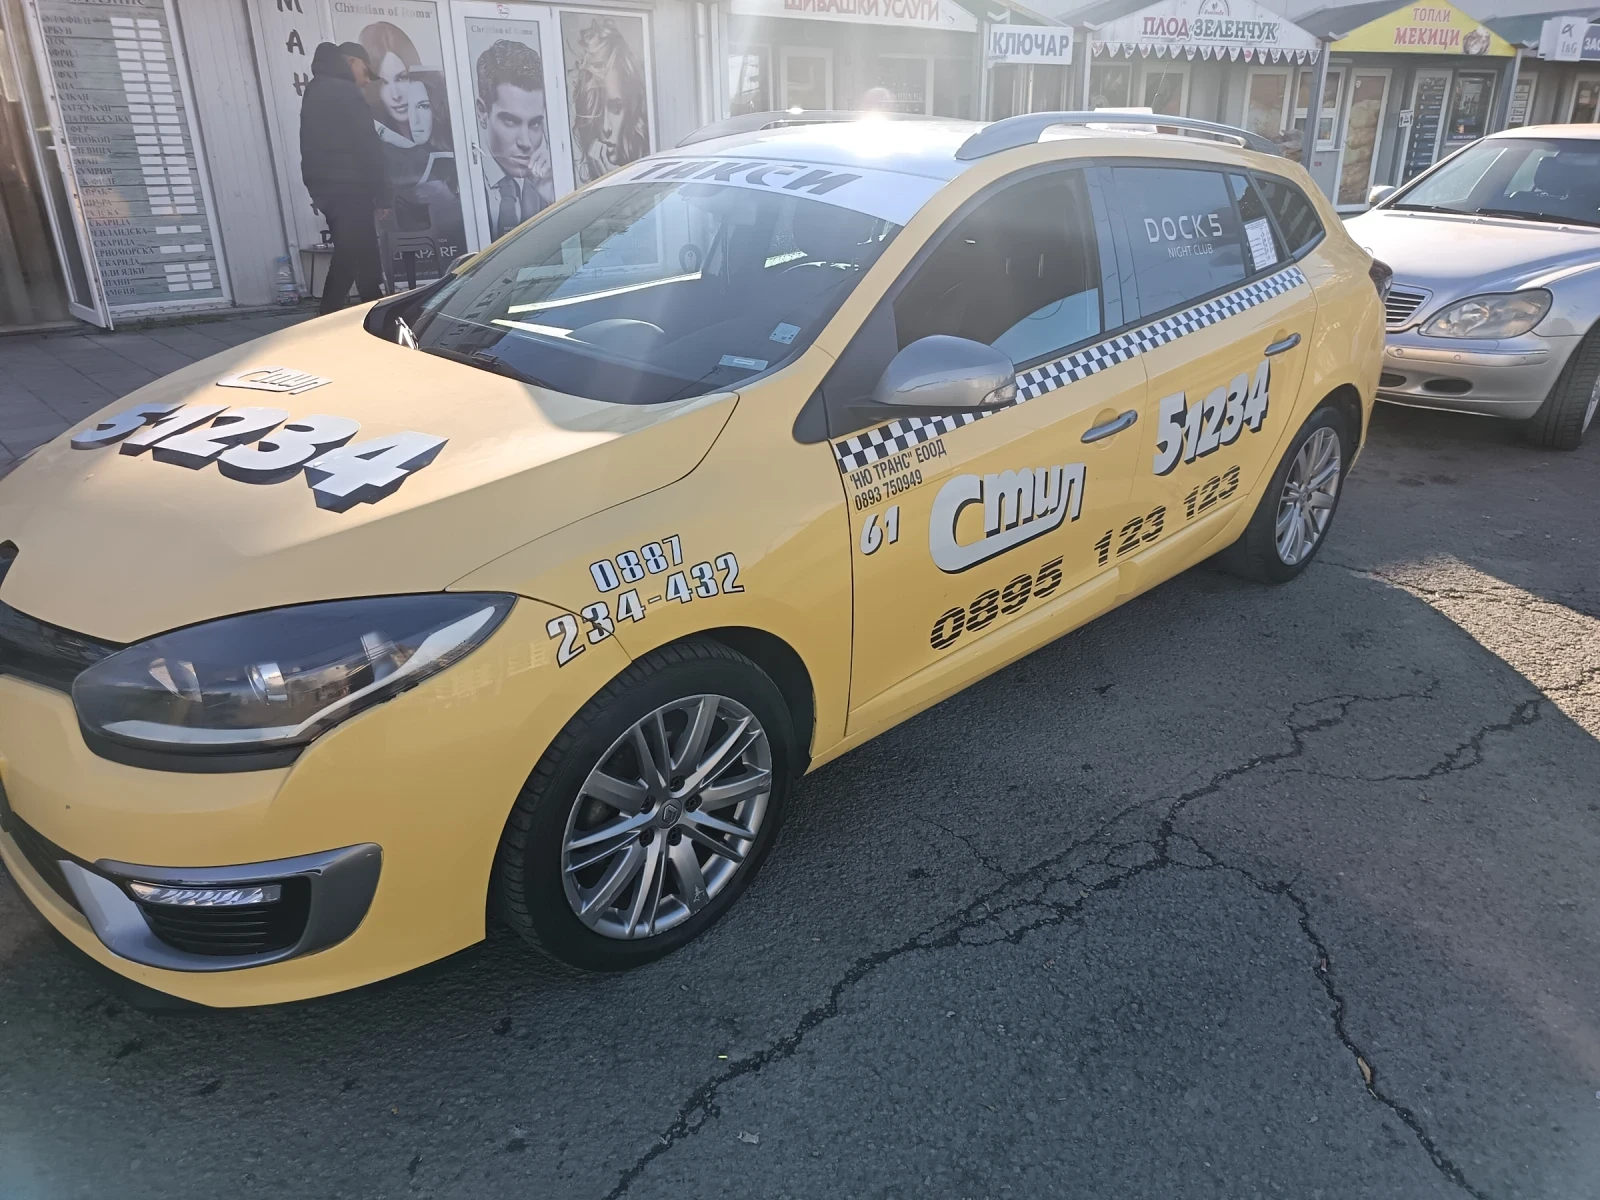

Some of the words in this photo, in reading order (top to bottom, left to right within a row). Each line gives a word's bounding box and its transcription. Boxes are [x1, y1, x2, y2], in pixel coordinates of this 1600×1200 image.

[388, 7, 400, 17] of
[883, 0, 940, 22] УСЛУГИ
[1412, 7, 1451, 23] ТОПЛИ
[1142, 16, 1190, 39] ПЛОД
[1193, 19, 1278, 41] ЗЕЛЕНЧУК
[1393, 27, 1461, 51] МЕКИЦИ
[992, 31, 1071, 57] КЛЮЧАР
[68, 136, 112, 144] ЕРНОКОП
[630, 159, 864, 196] ТАКСИ
[96, 247, 155, 258] ЕРНОМОРСКА
[1167, 246, 1193, 259] NIGHT
[1193, 243, 1214, 255] CLUB
[101, 269, 120, 278] ИДИ
[105, 287, 136, 298] АМСИЯ
[1152, 357, 1271, 477] 51234
[70, 402, 450, 515] 51234
[915, 438, 948, 464] ЕООД
[854, 486, 883, 512] 0893
[882, 468, 924, 499] 750949
[859, 505, 900, 557] 61
[588, 533, 684, 594] 0887
[929, 554, 1065, 652] 0895
[1093, 504, 1168, 568] 123
[1183, 463, 1242, 521] 123
[545, 551, 746, 669] 234-432
